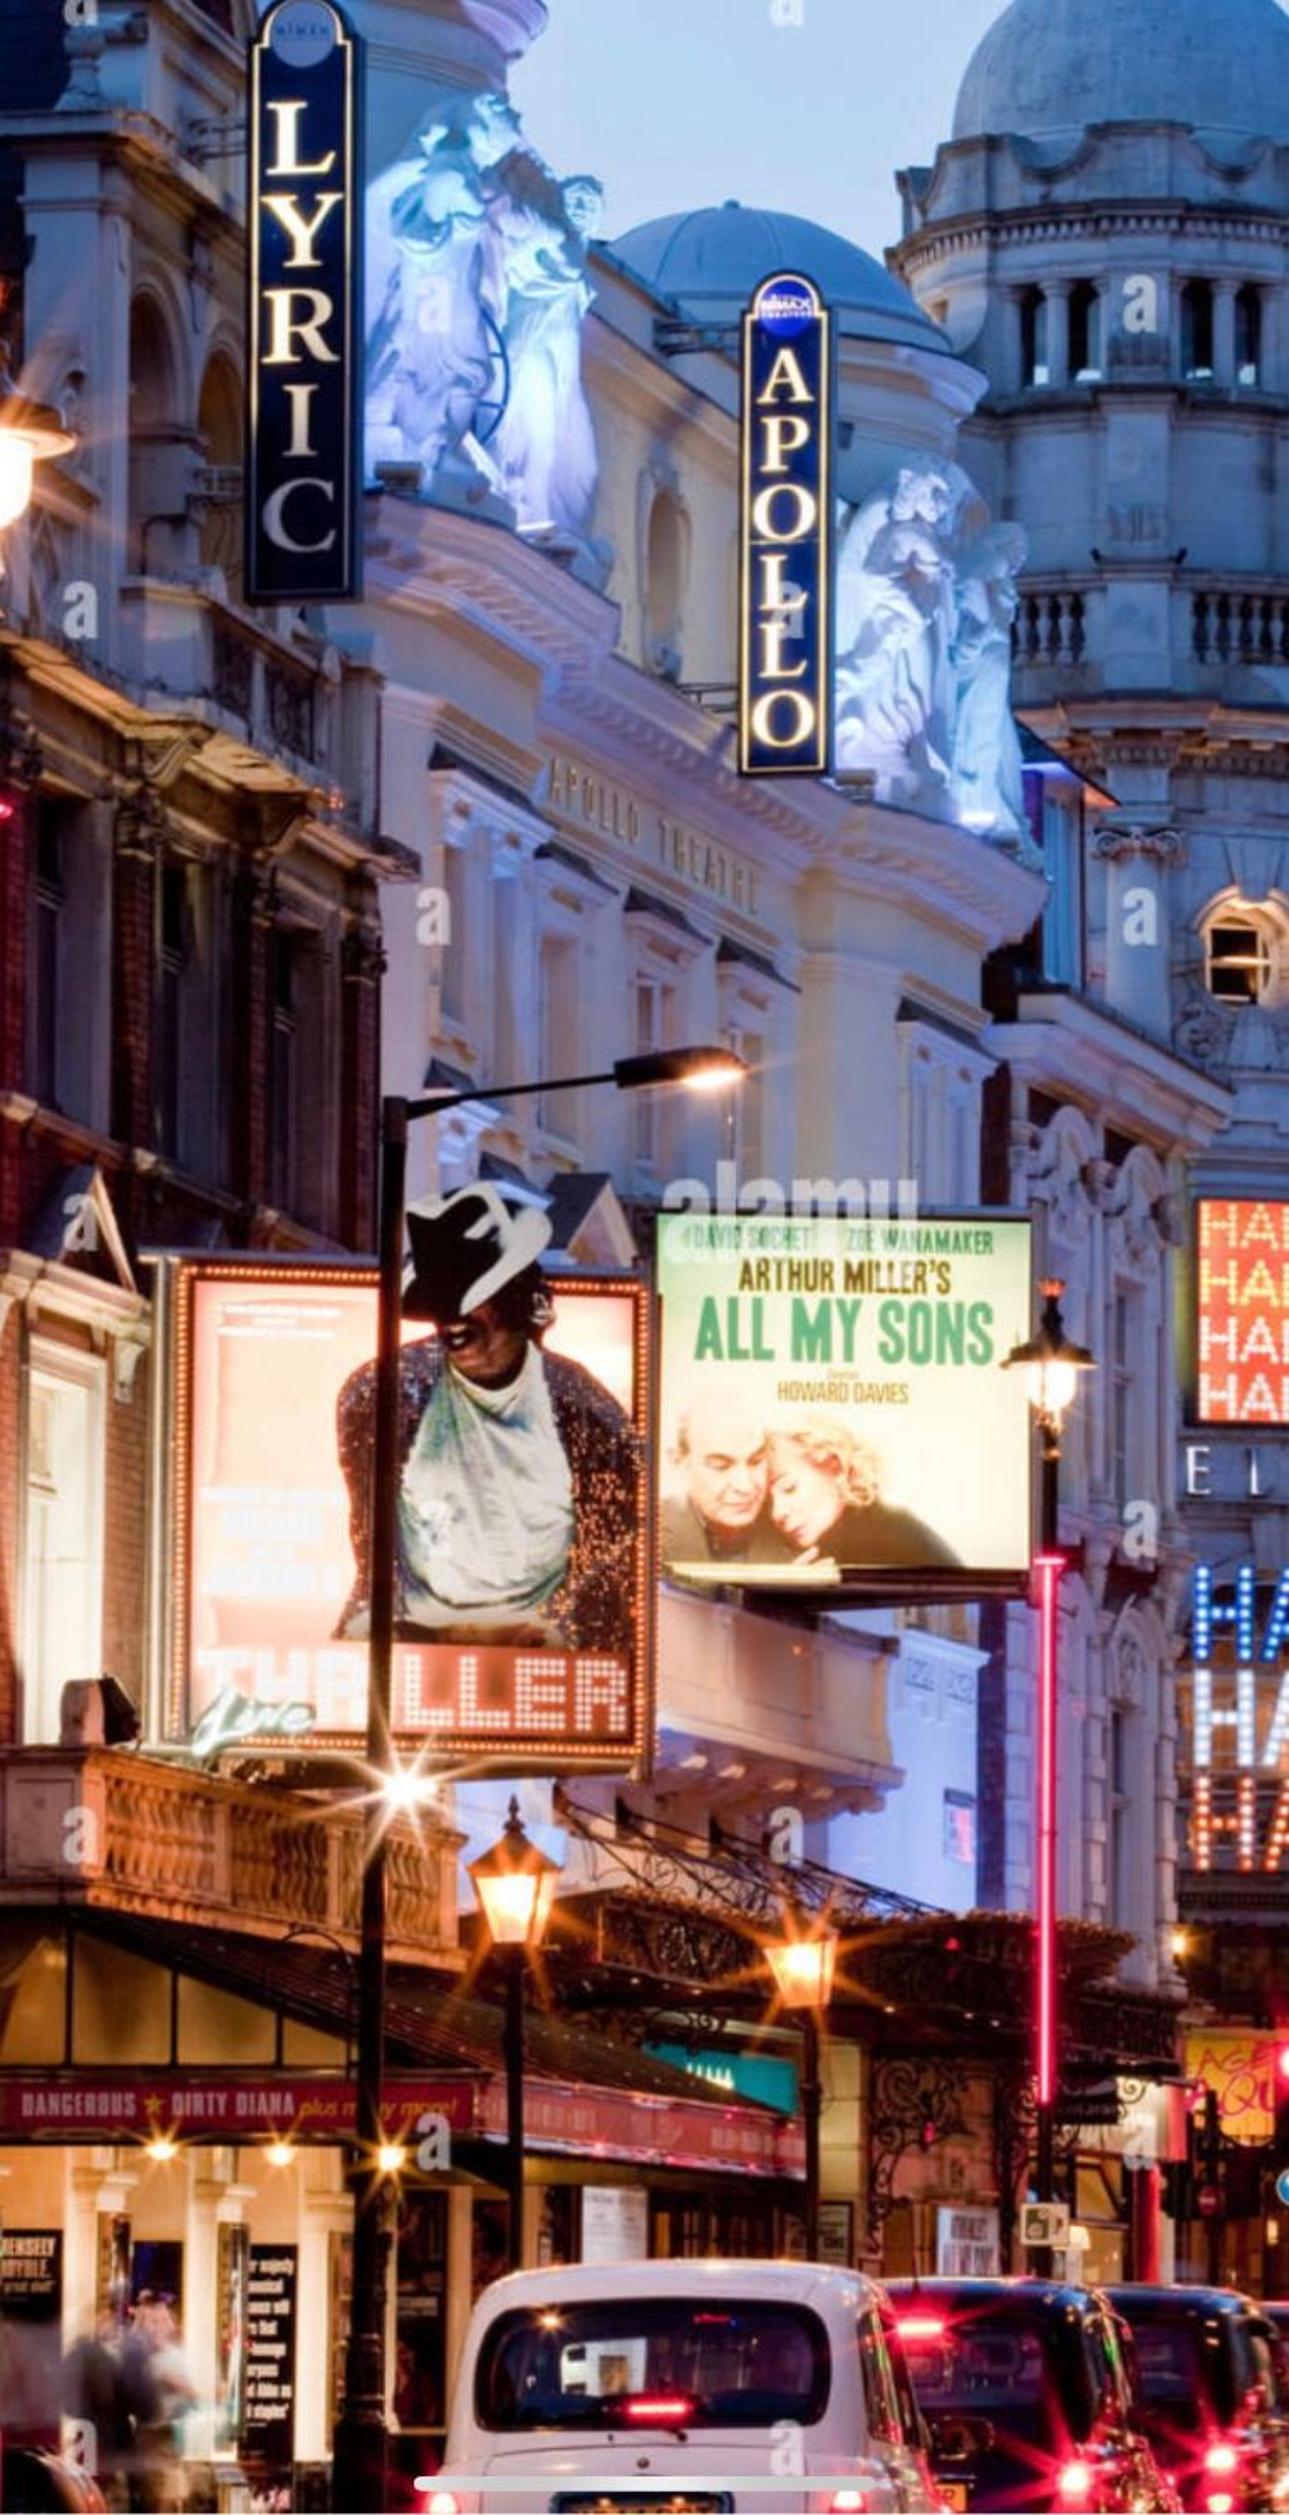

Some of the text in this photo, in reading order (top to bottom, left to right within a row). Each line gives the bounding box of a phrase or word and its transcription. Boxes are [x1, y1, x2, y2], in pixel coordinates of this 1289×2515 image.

[261, 100, 344, 554] LYRIC
[751, 347, 816, 748] APOLLO
[549, 756, 758, 915] APOLLO THEATRE
[739, 1257, 951, 1296] ARTHUR MILLER'S
[883, 1229, 994, 1255] WANAMAKER
[694, 1296, 994, 1366] ALL MY SONS
[777, 1380, 909, 1404] HOWARD DAVIES
[197, 1647, 627, 1734] THRLLER
[22, 2092, 136, 2118] DANGEROUS
[171, 2092, 227, 2117] DIRTY
[236, 2092, 294, 2117] DIANA
[300, 2098, 337, 2120] plus
